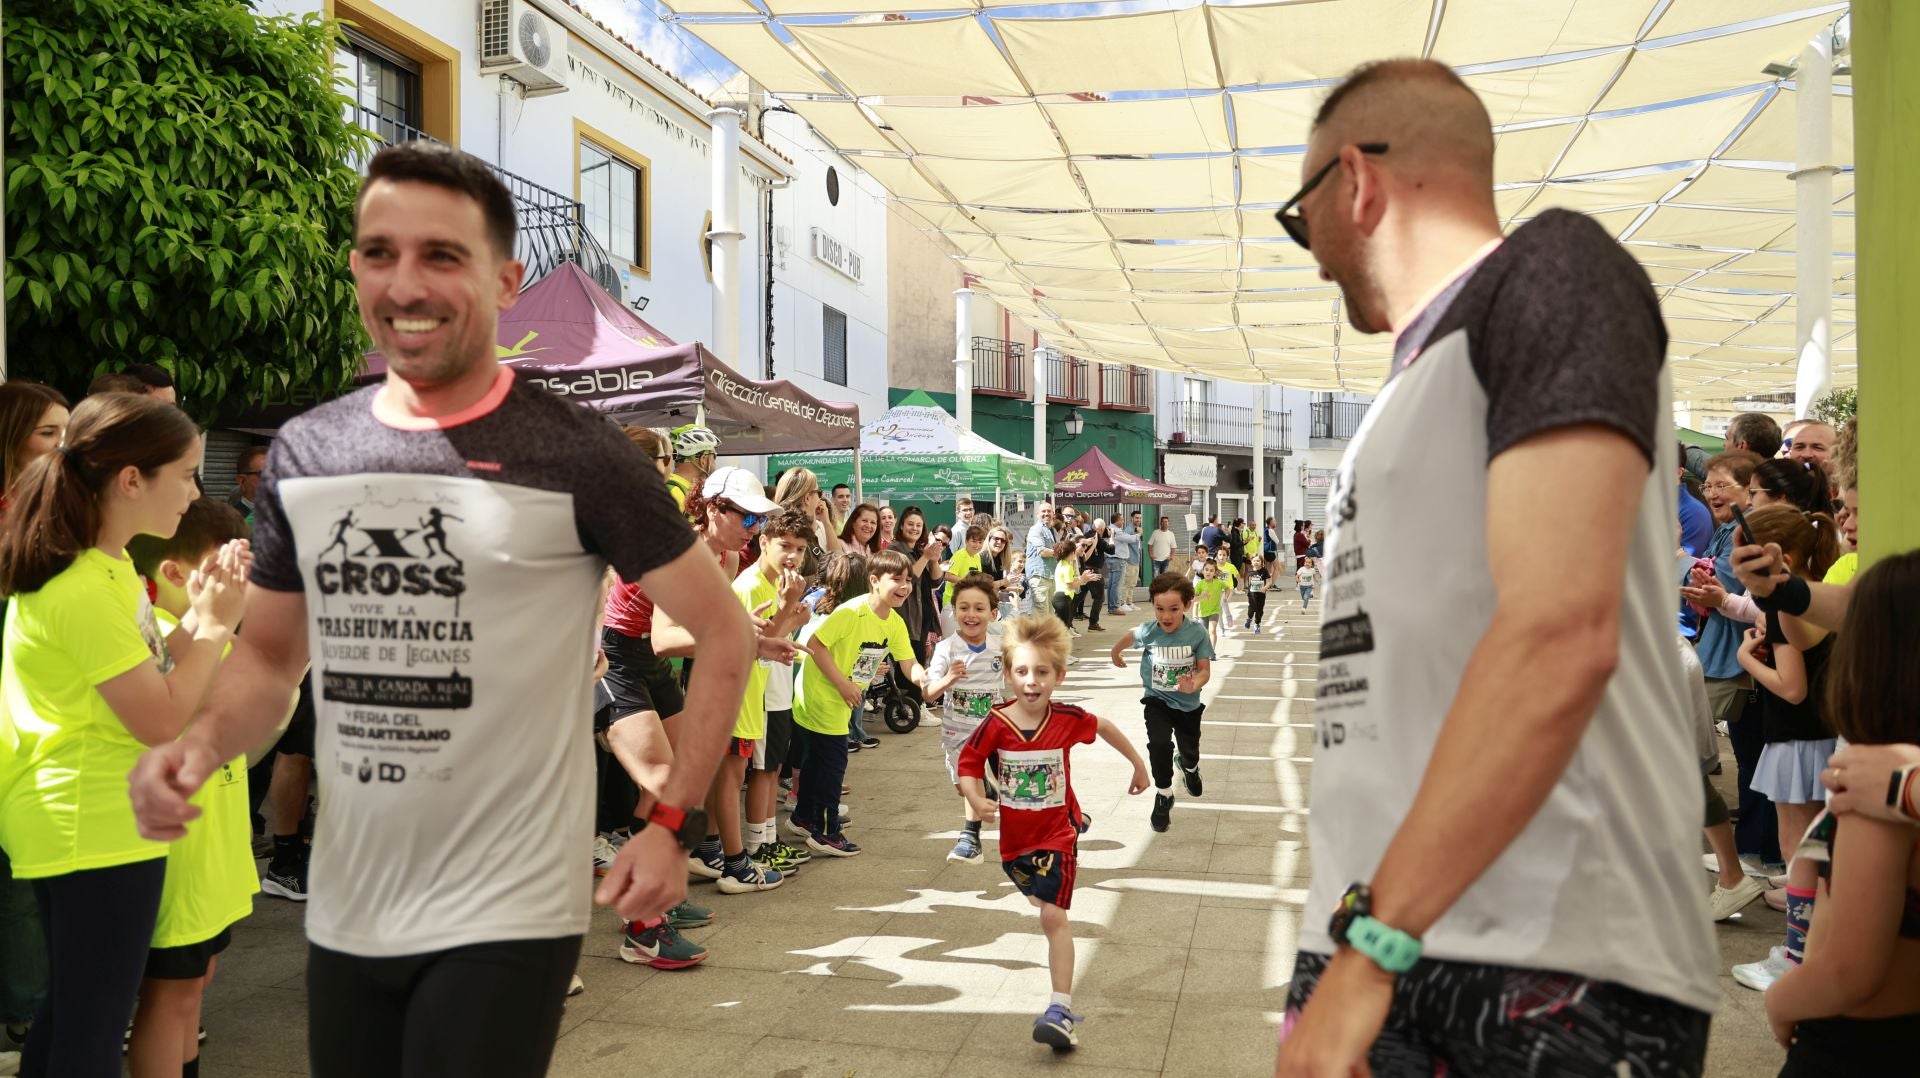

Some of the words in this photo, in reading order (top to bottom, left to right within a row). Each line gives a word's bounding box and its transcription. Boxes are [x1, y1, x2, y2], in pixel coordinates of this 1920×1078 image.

[823, 234, 843, 268] DISCO
[849, 251, 861, 279] PUB
[710, 369, 763, 407] Dirección
[763, 391, 801, 416] General
[801, 404, 816, 420] de
[816, 407, 856, 428] Deportes
[777, 457, 837, 466] MANCOMUNIDAD
[838, 456, 873, 464] INTERAL
[949, 455, 987, 463] OLIVENZA
[351, 528, 421, 559] X
[315, 561, 466, 597] CROSS
[350, 603, 384, 614] VIVE
[397, 605, 416, 616] LA
[317, 617, 474, 641] TRASHUMANCIA
[379, 646, 396, 662] DE
[406, 644, 471, 667] LEGANÉS
[436, 682, 468, 695] REAL
[353, 710, 390, 725] FERIA
[393, 713, 423, 727] DEL
[967, 697, 993, 718] 30
[367, 728, 451, 741] ARTESANO
[1013, 770, 1047, 798] 21
